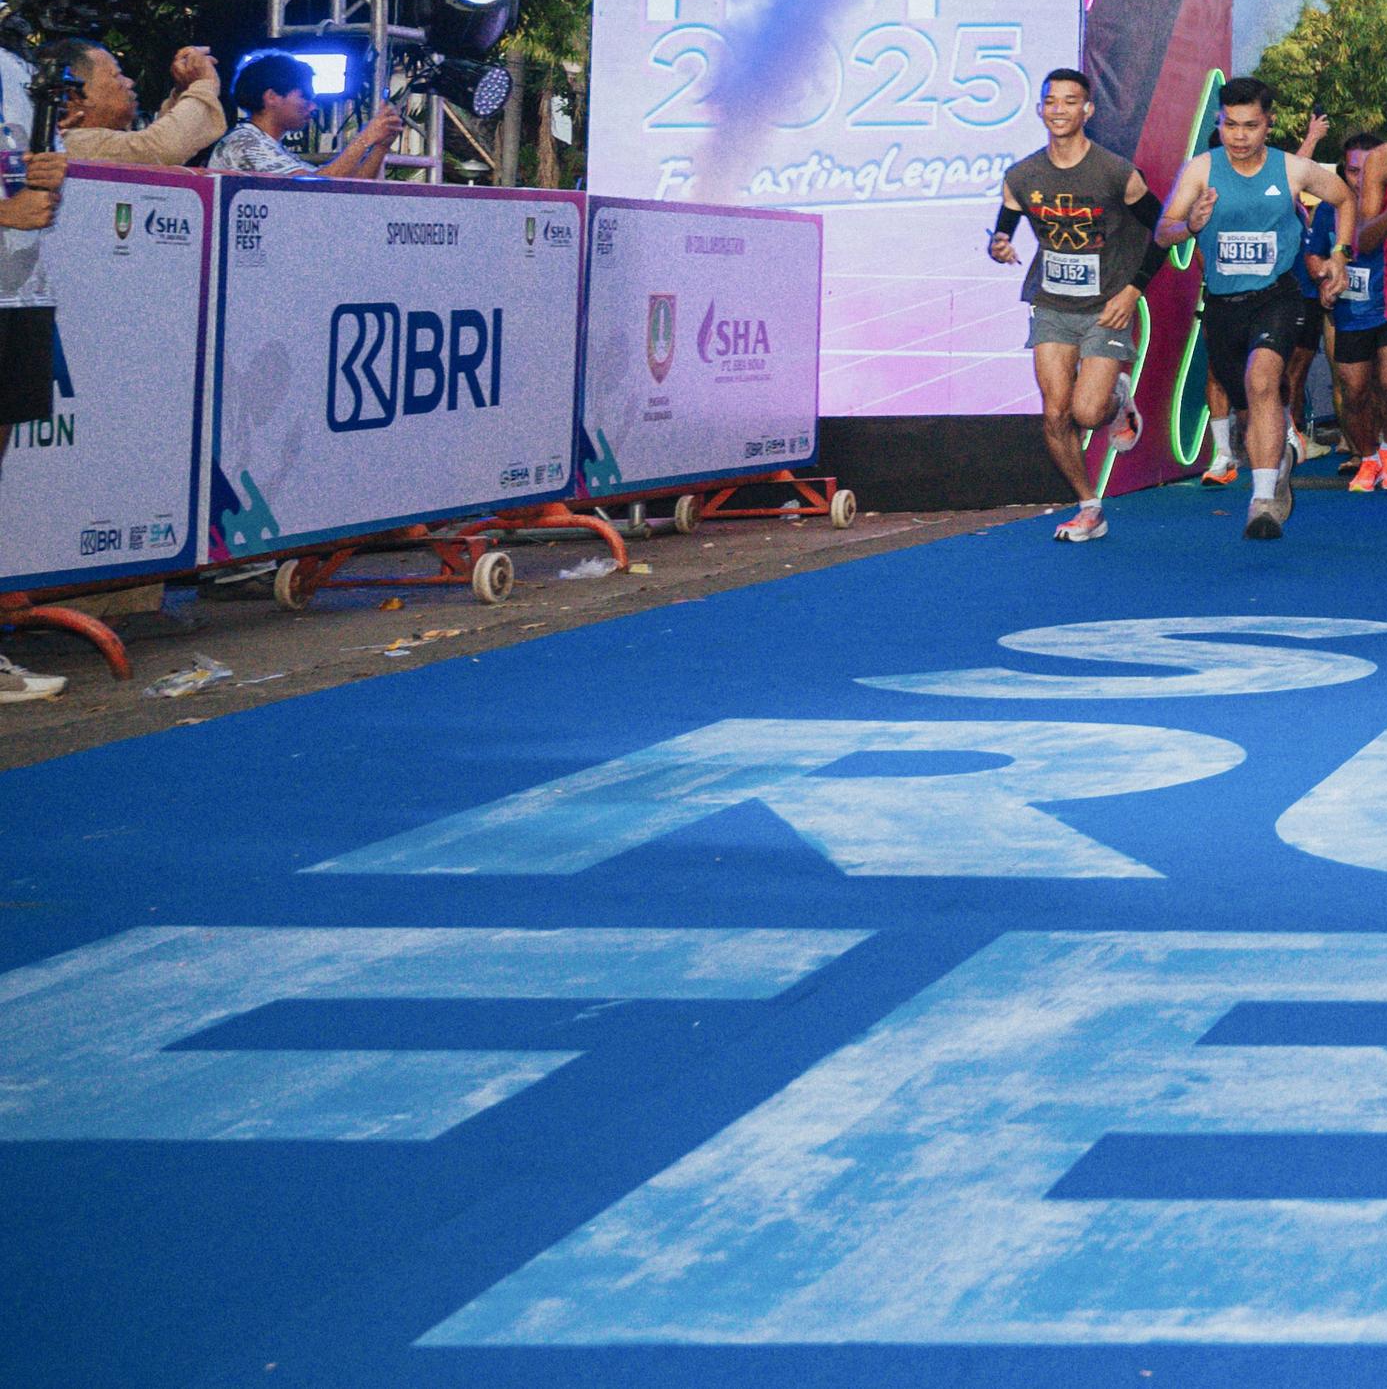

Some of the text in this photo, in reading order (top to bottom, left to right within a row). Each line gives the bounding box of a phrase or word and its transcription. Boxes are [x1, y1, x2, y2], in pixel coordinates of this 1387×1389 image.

[237, 204, 268, 219] SOLO
[156, 217, 191, 235] SHA
[236, 220, 260, 233] RUN
[386, 222, 460, 246] SPONSORED BY
[235, 235, 262, 250] FEST
[1219, 242, 1263, 260] N9151
[715, 319, 771, 357] SHA
[403, 308, 503, 416] BRI
[96, 528, 122, 552] BRI
